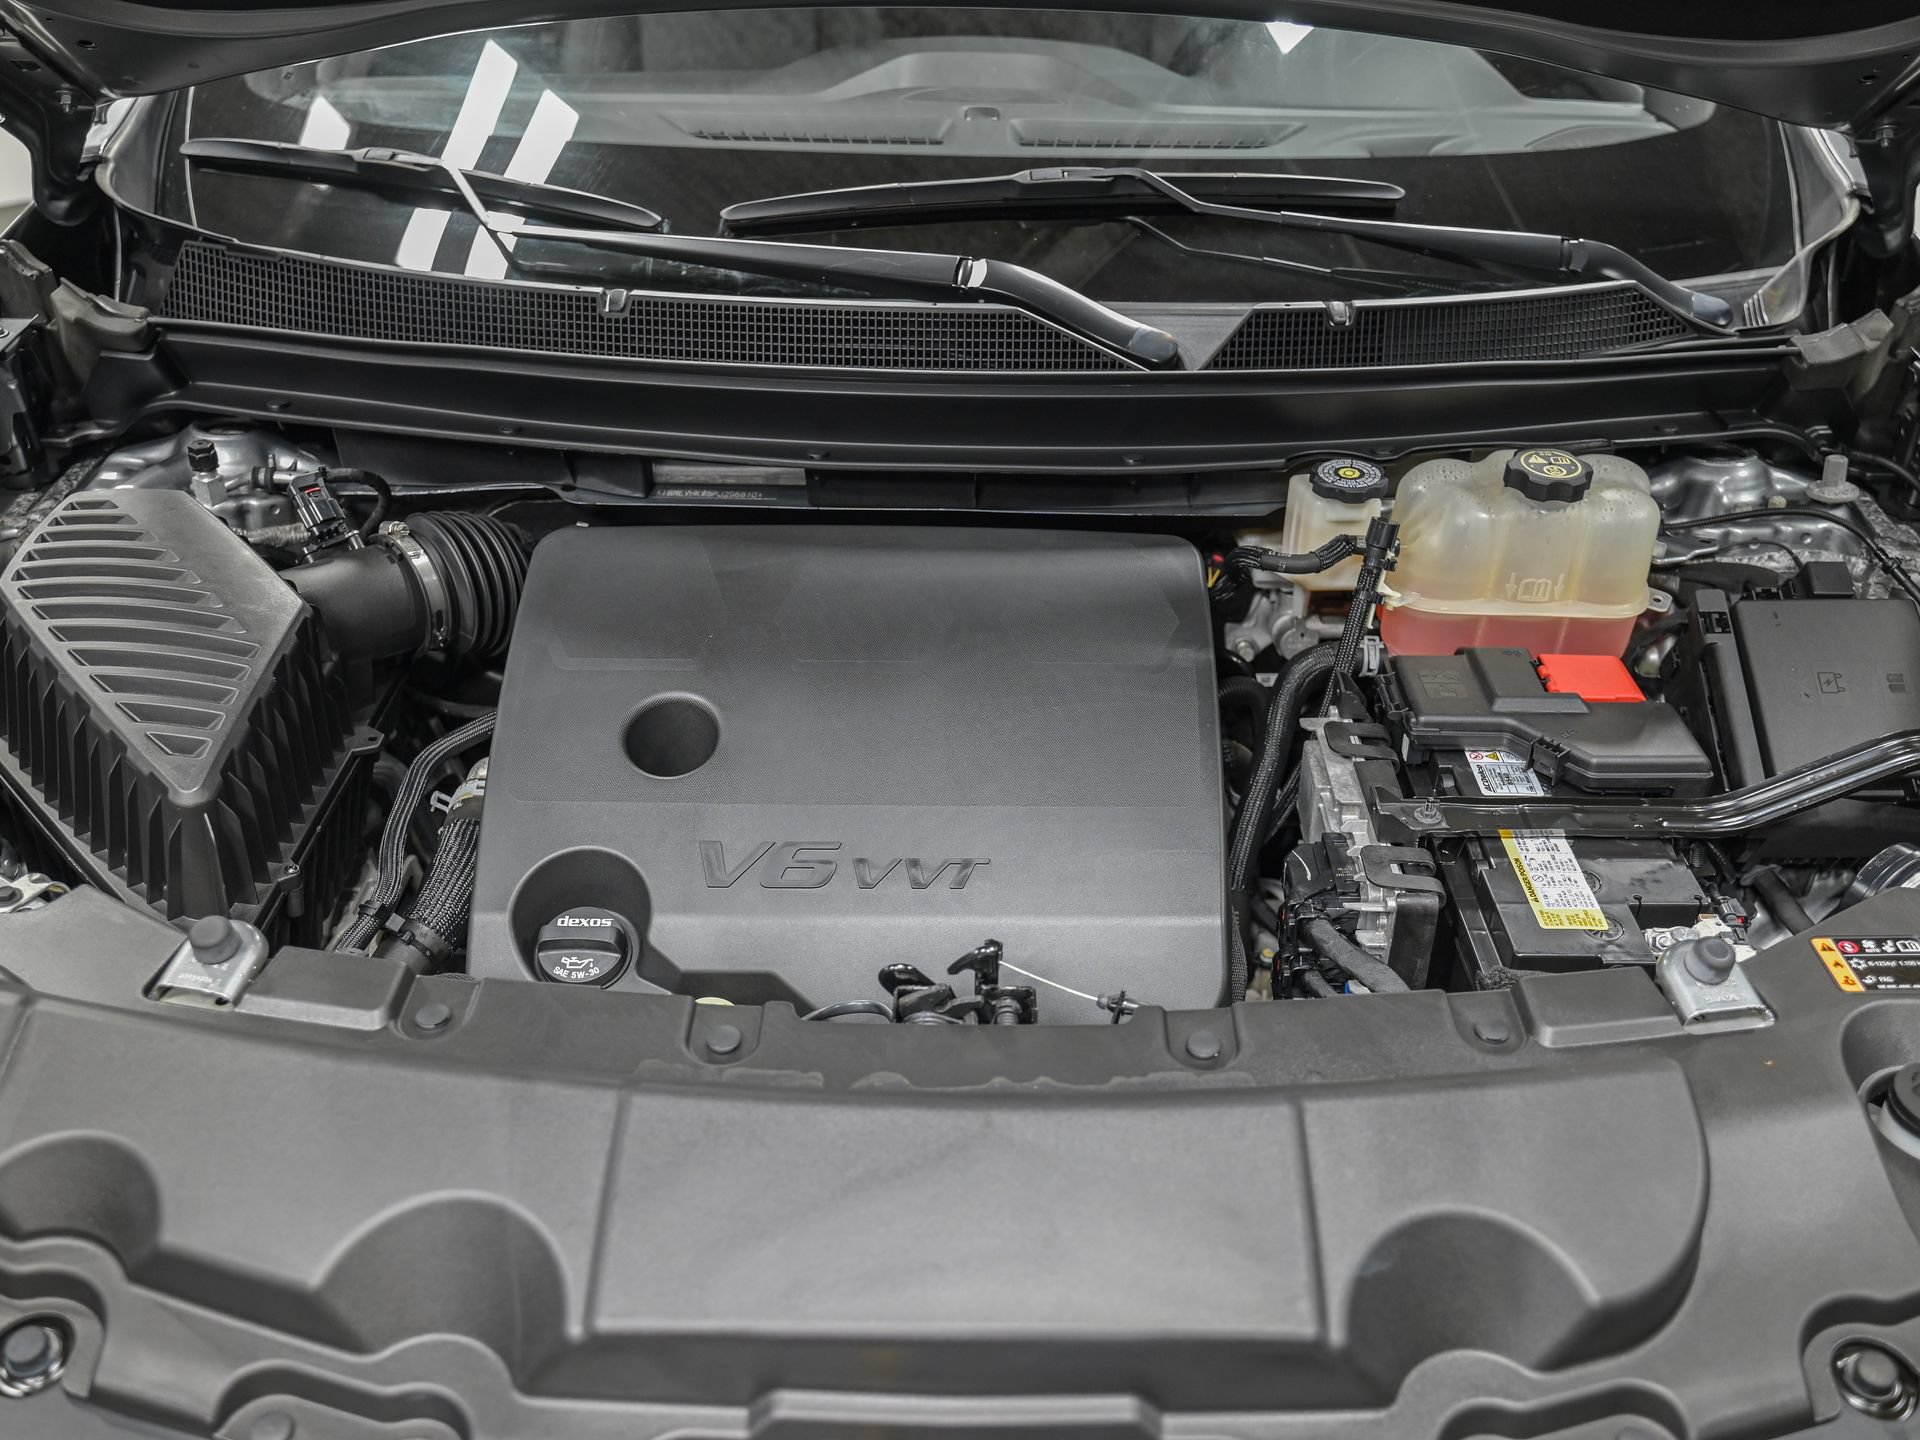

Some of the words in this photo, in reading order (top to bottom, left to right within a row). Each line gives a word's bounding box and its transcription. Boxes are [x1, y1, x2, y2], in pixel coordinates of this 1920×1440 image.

[1476, 764, 1493, 793] ACDelco
[699, 840, 842, 889] V6
[852, 857, 991, 889] VVT
[557, 916, 614, 927] dexos
[553, 966, 569, 978] SAE
[571, 966, 600, 979] 5W-30
